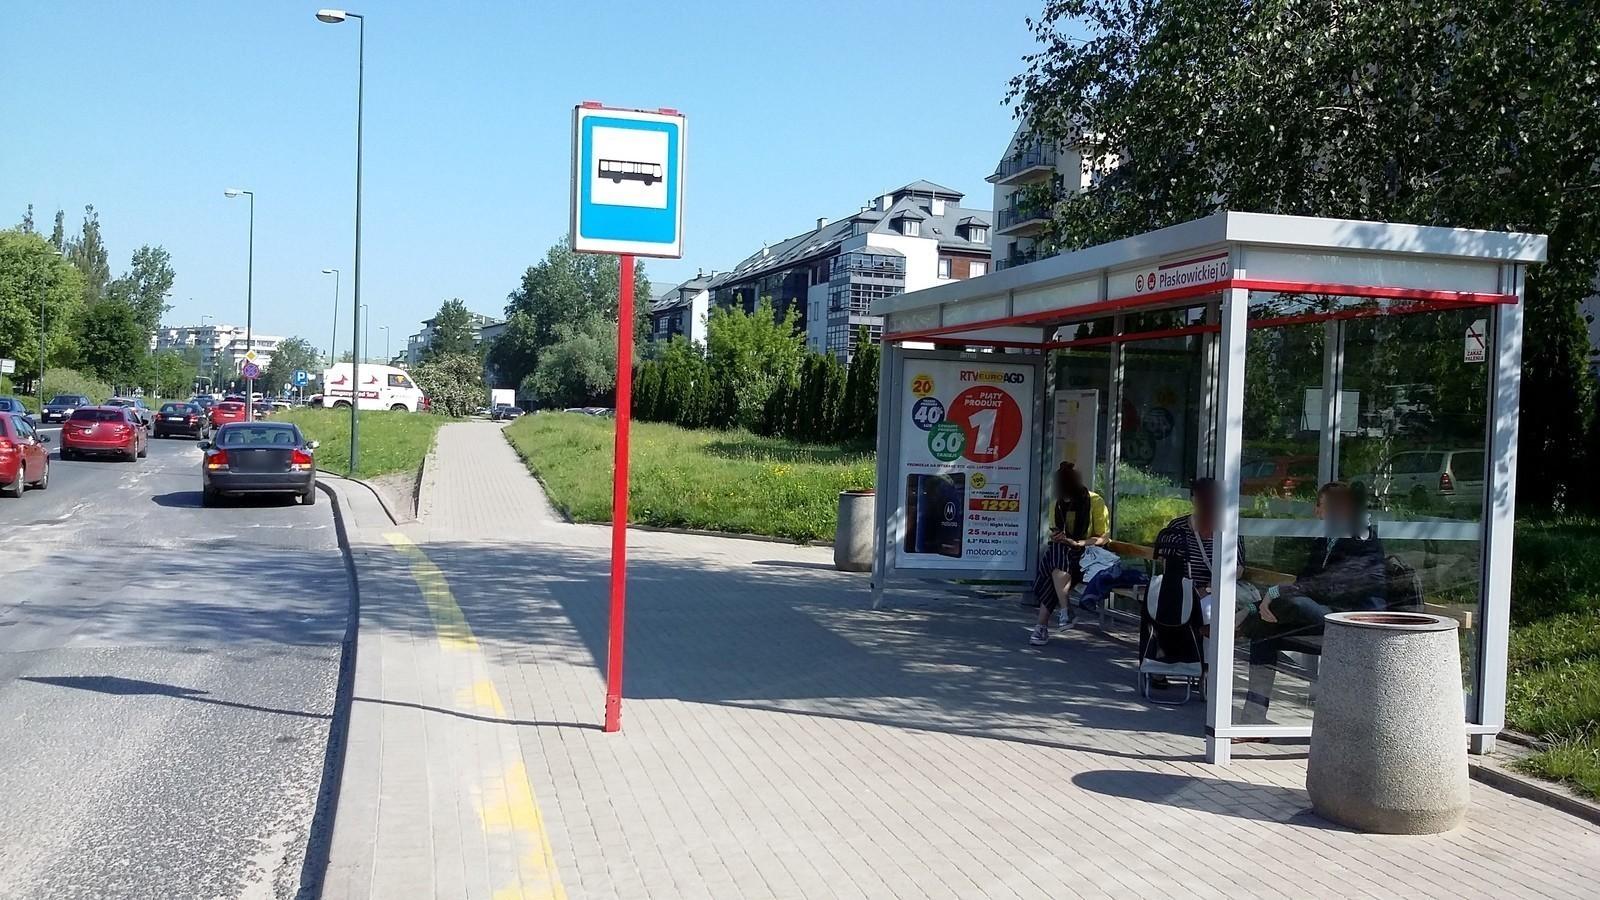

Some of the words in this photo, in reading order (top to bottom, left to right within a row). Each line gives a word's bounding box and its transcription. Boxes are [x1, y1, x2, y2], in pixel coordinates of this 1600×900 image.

[1220, 262, 1229, 276] 0
[297, 371, 306, 382] P
[964, 399, 1003, 408] PRODUKT
[981, 500, 1018, 511] 1299
